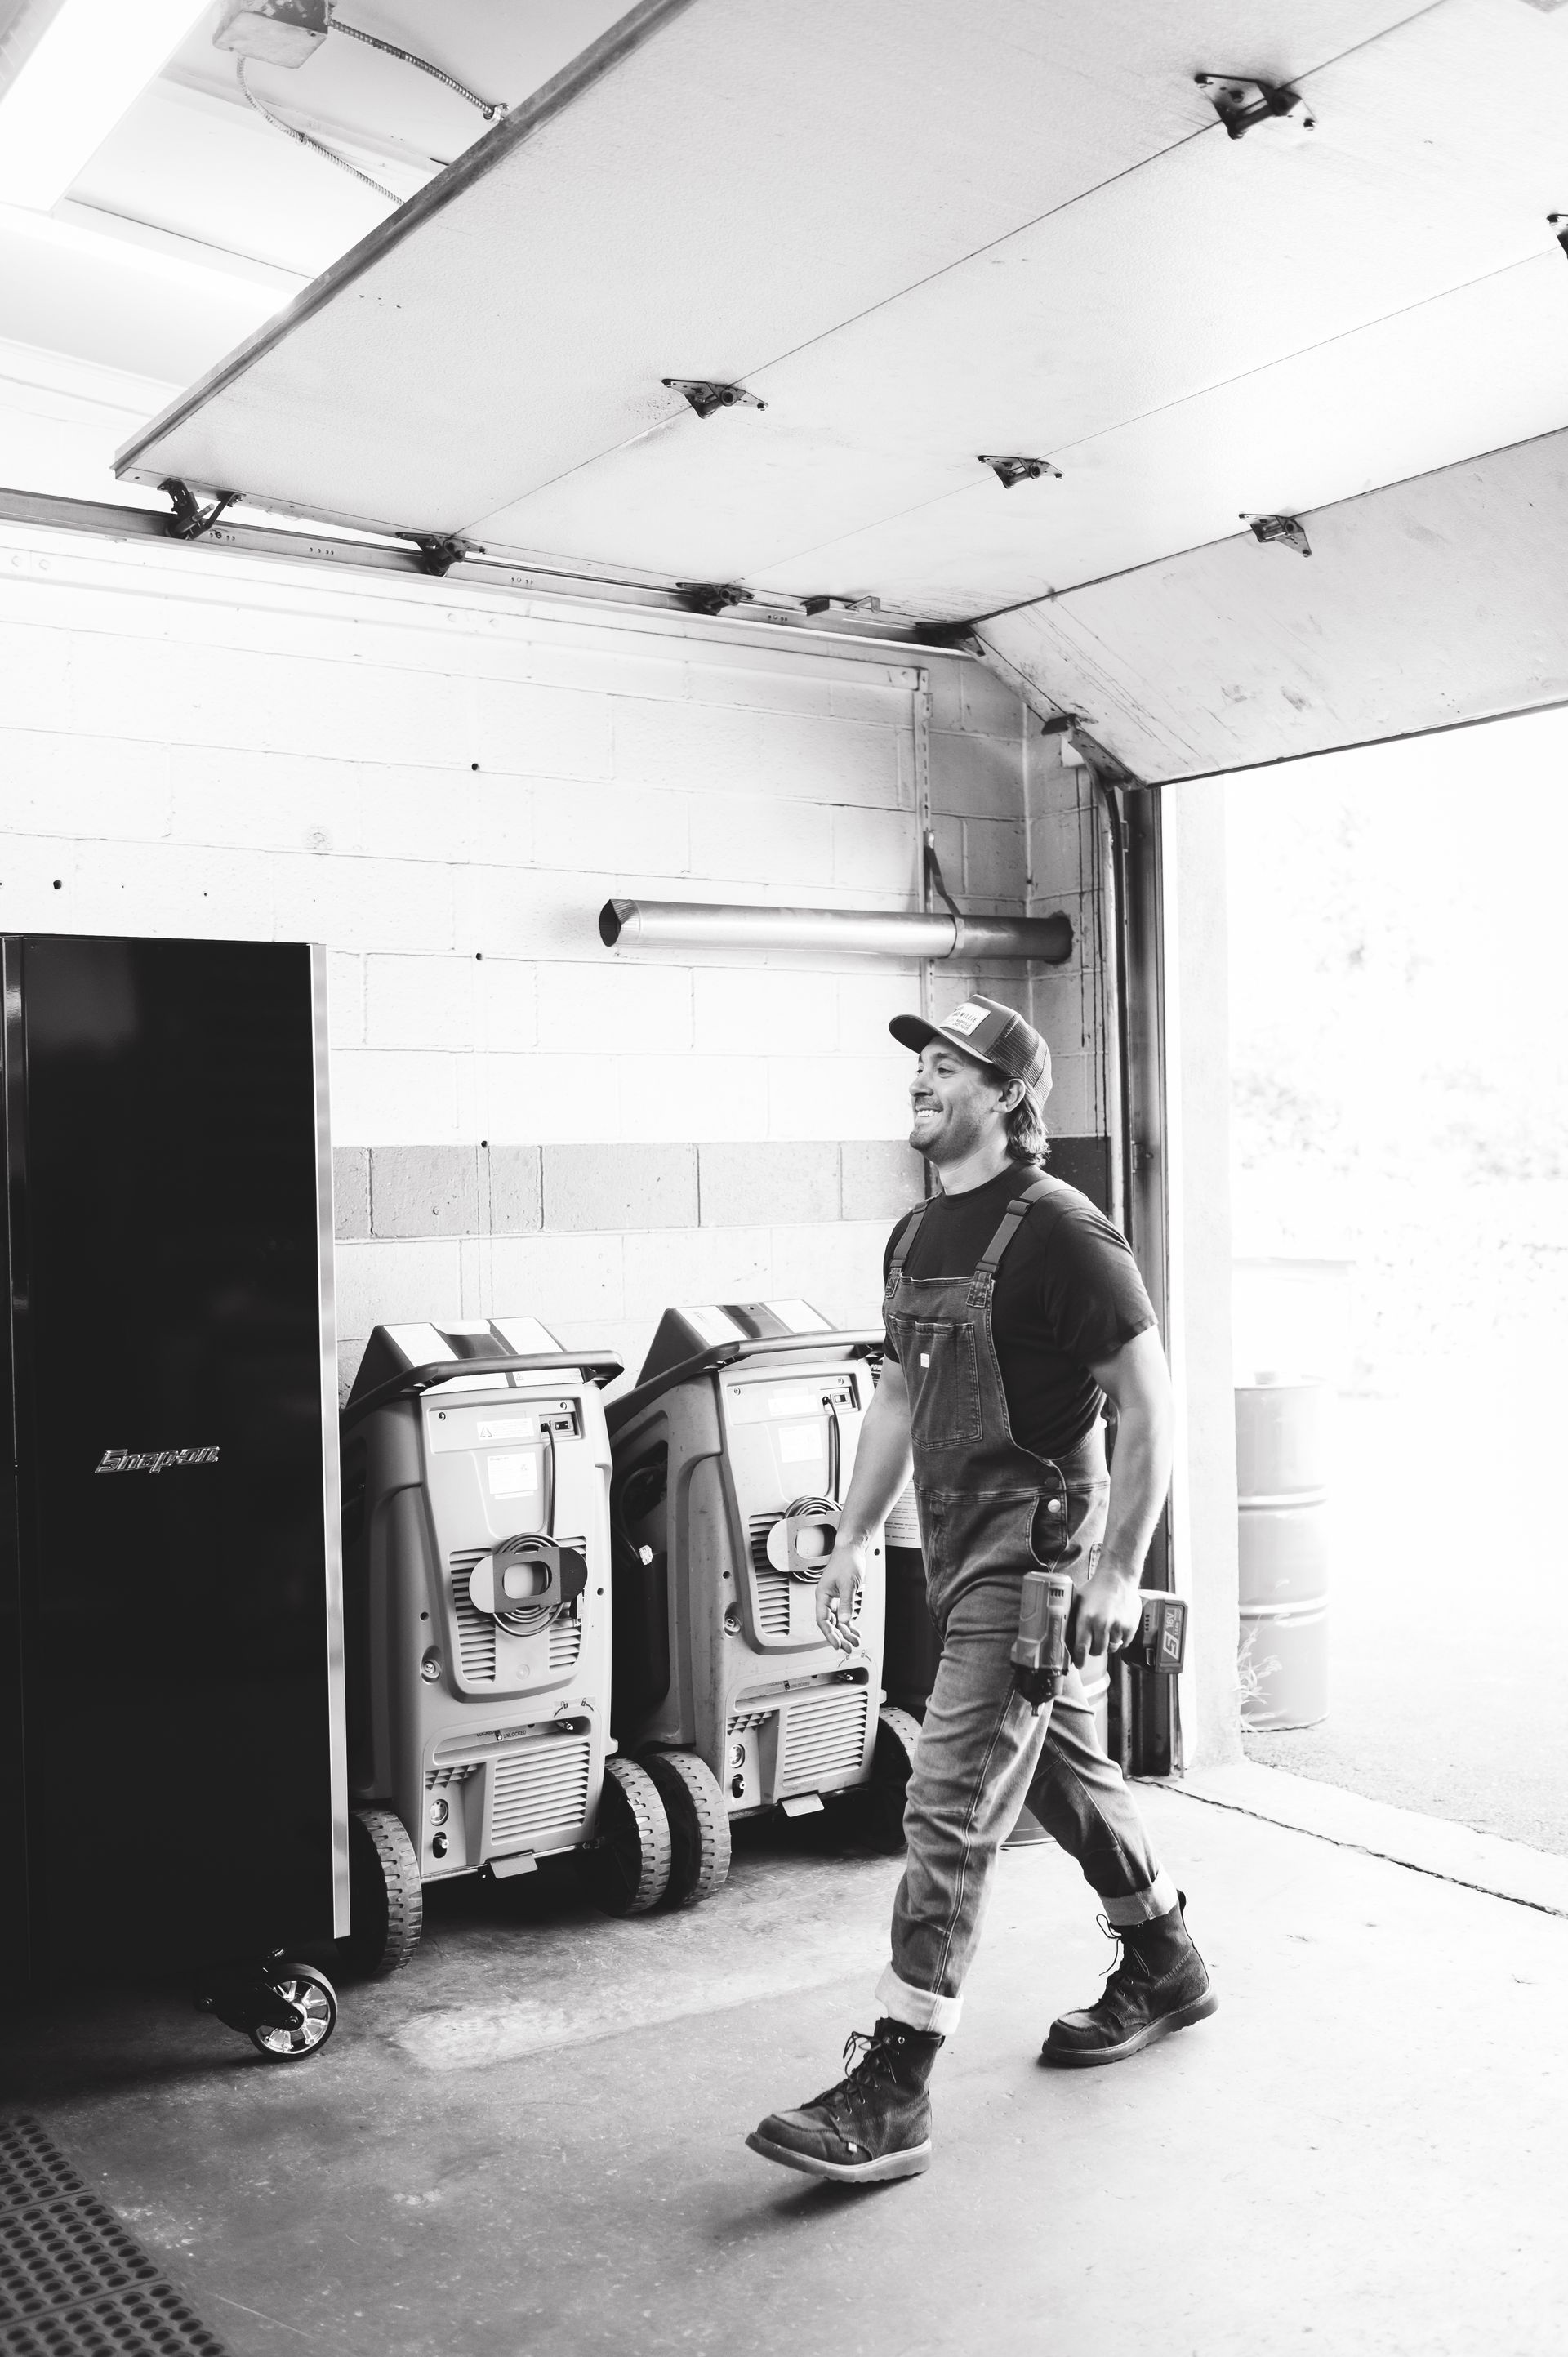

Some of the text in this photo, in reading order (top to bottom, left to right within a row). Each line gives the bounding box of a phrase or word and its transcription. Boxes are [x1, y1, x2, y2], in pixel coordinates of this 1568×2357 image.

[94, 1446, 220, 1473] Snap-on
[1166, 1613, 1174, 1628] 18V
[504, 1730, 526, 1738] UNLOCKED
